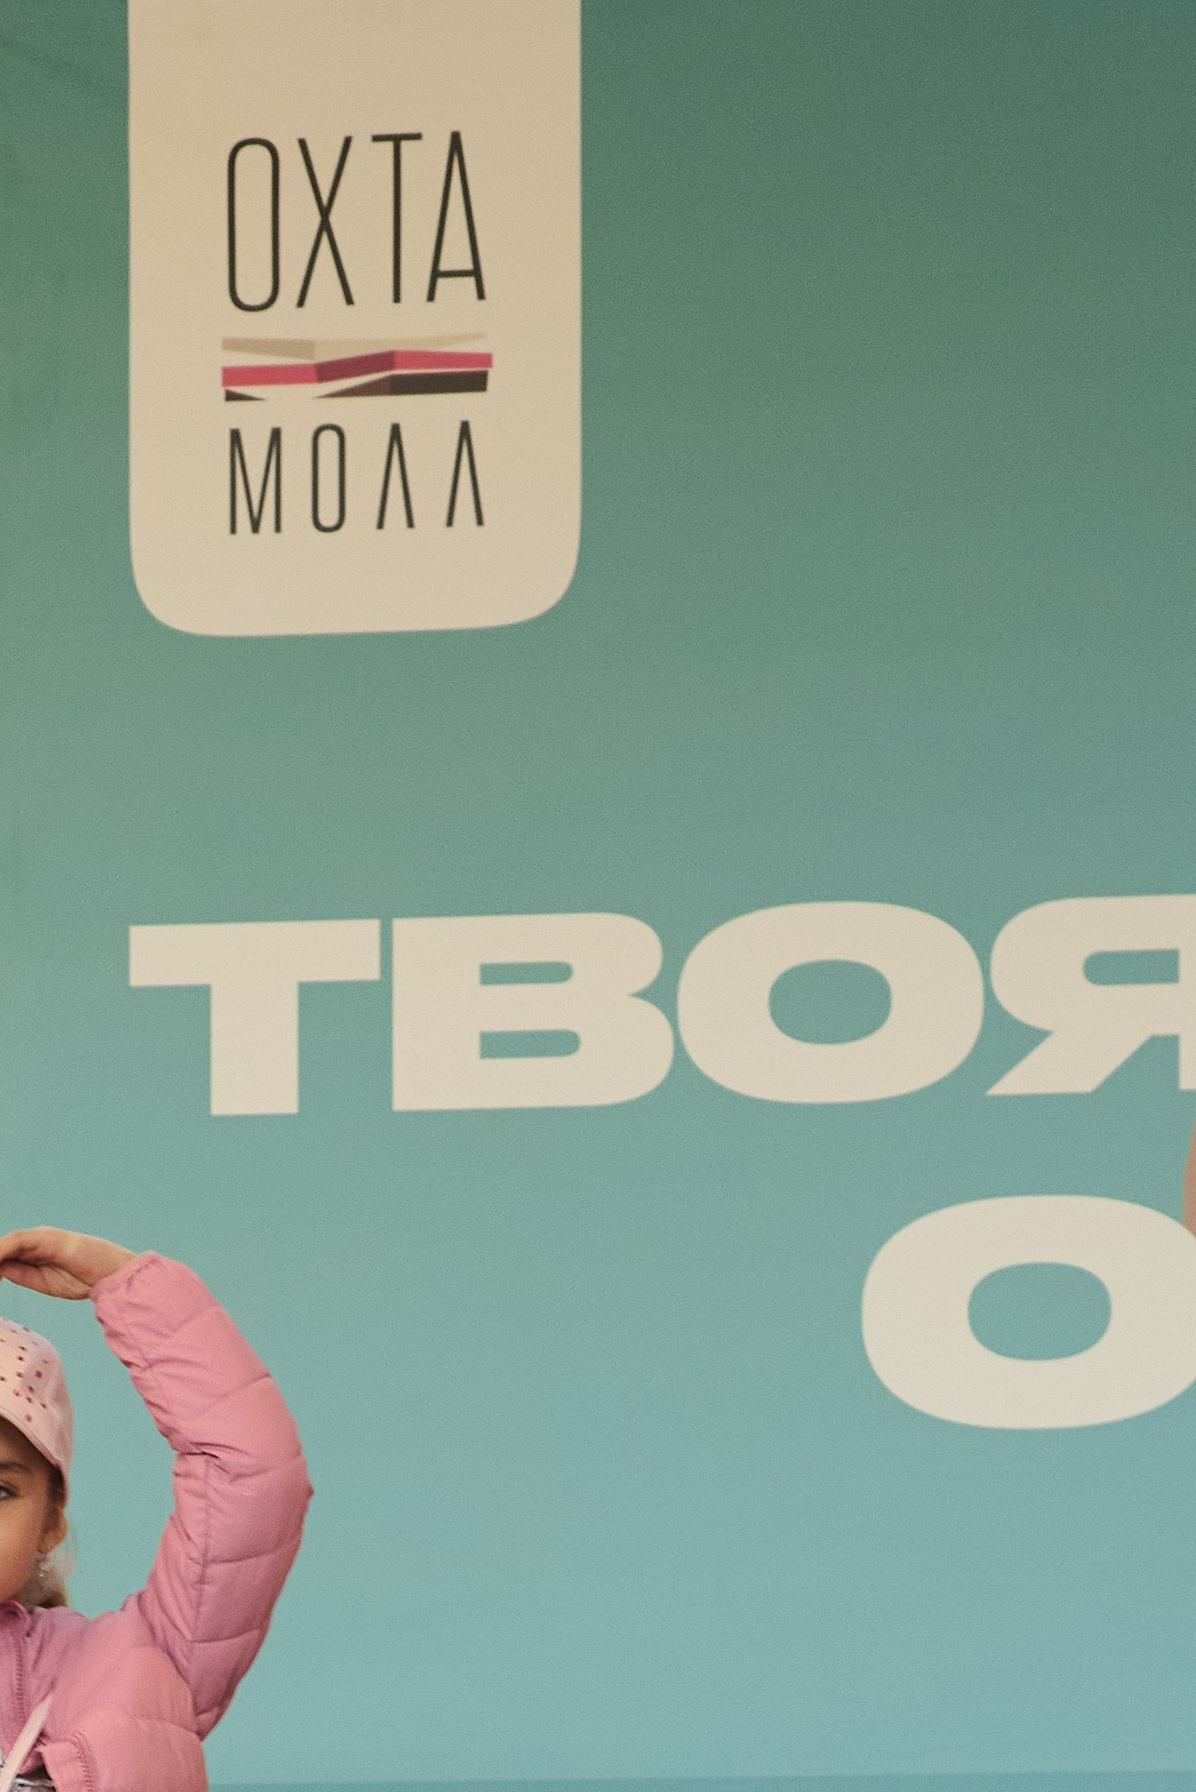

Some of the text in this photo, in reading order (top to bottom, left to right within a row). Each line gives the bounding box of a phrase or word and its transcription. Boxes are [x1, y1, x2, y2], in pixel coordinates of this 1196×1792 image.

[227, 130, 486, 312] ОХТА
[229, 420, 484, 535] МОЛЛ
[129, 893, 1196, 1116] ТВОЯ
